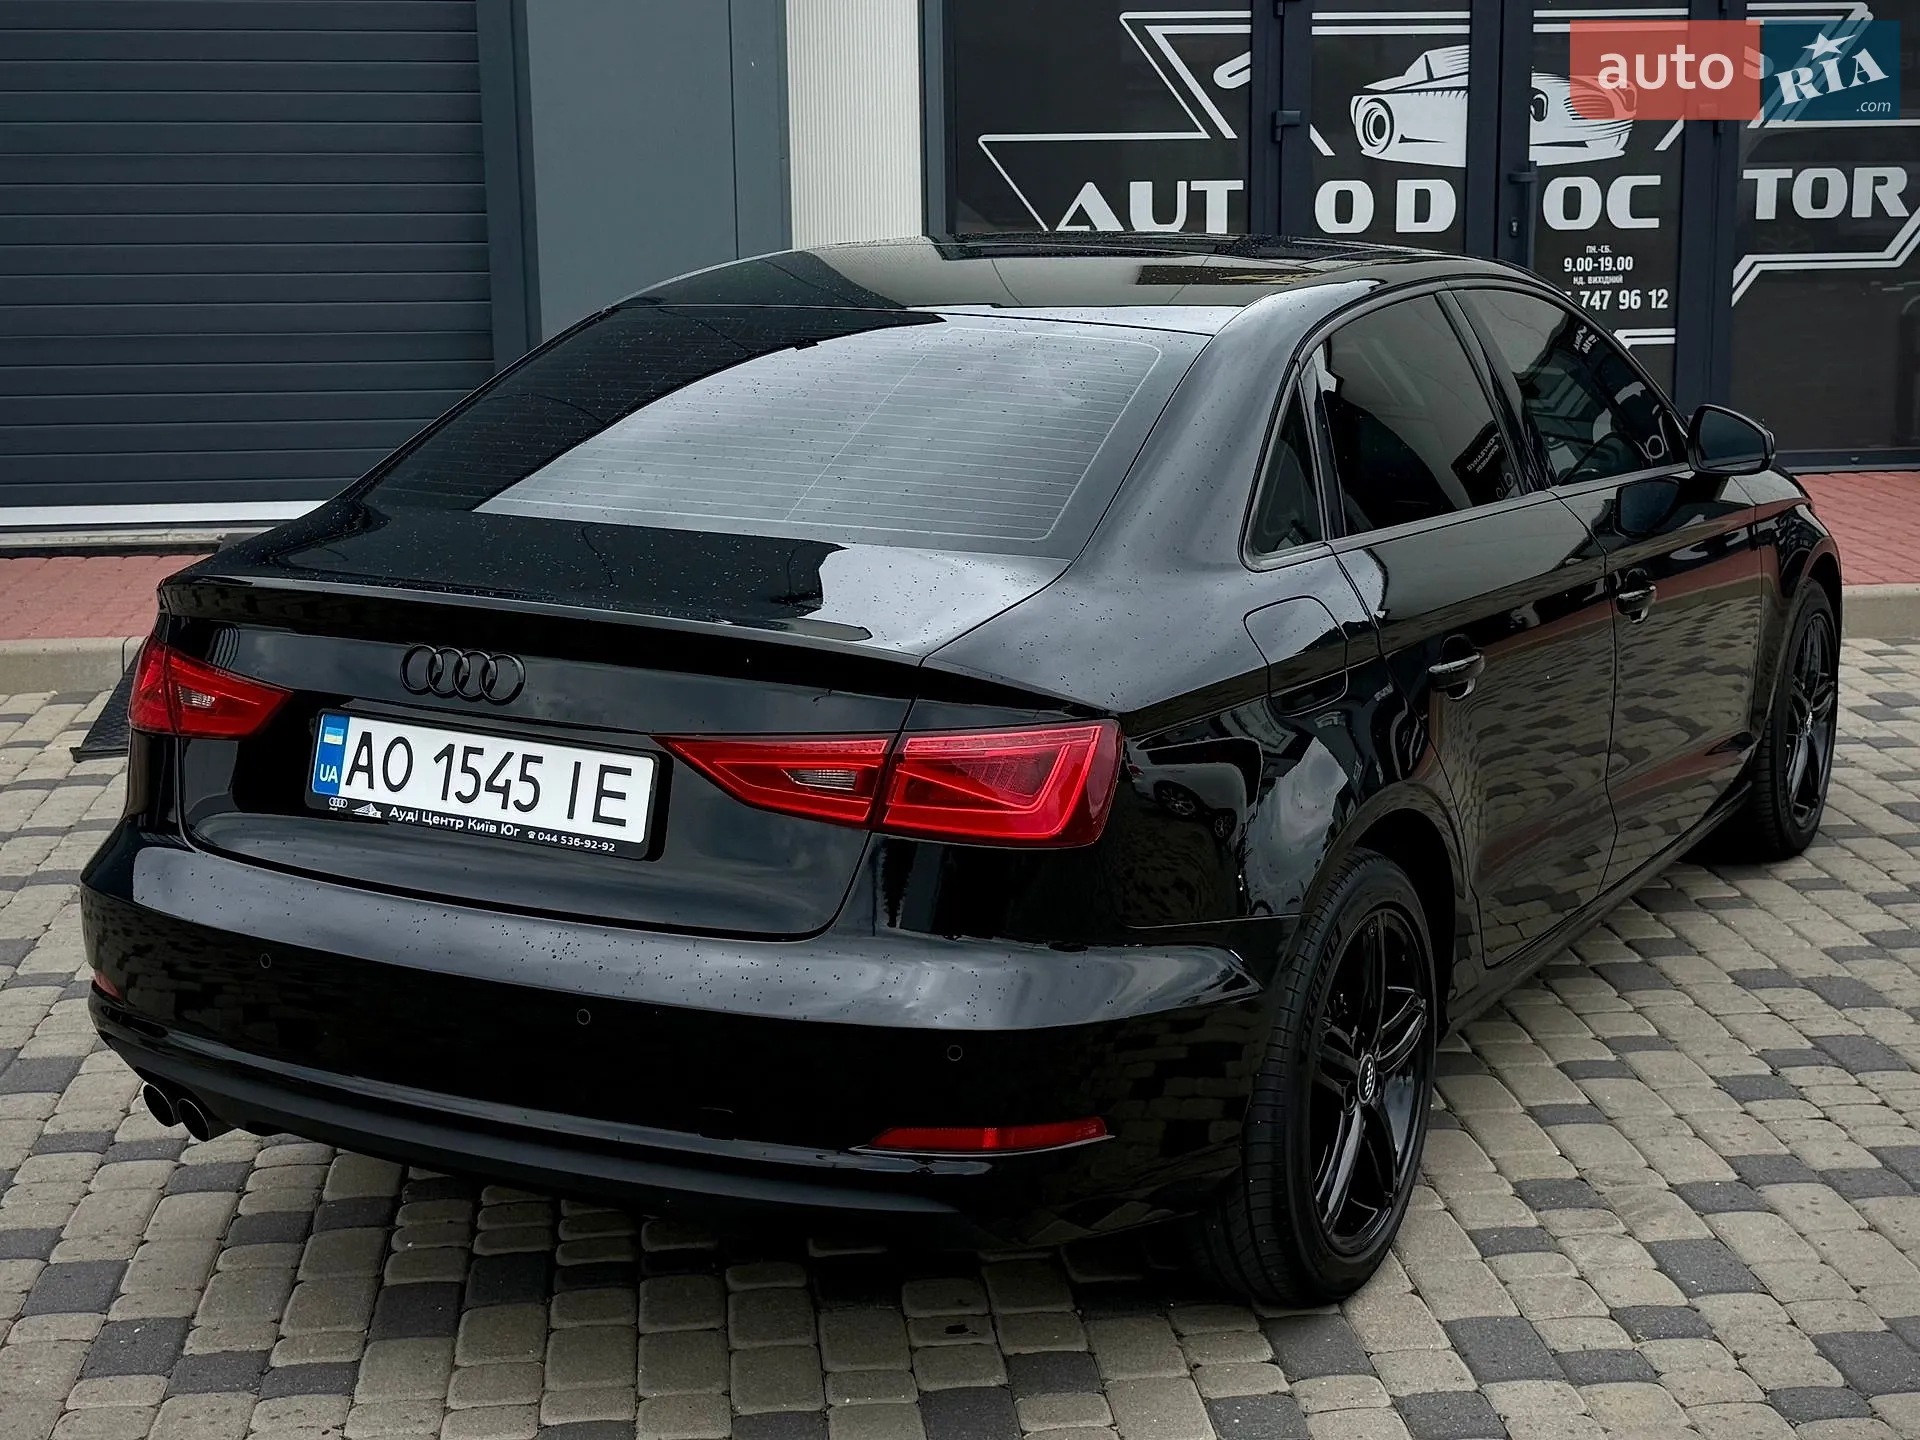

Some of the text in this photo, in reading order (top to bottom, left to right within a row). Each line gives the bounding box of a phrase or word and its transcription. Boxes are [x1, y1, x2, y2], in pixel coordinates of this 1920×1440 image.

[1564, 256, 1633, 272] 9.00-19.00
[1579, 288, 1668, 310] 747 96 12
[319, 763, 339, 784] UA
[345, 731, 632, 827] AO 1545 IE
[389, 806, 616, 852] Ауді Центр Київ Юг 044 536-92-92
